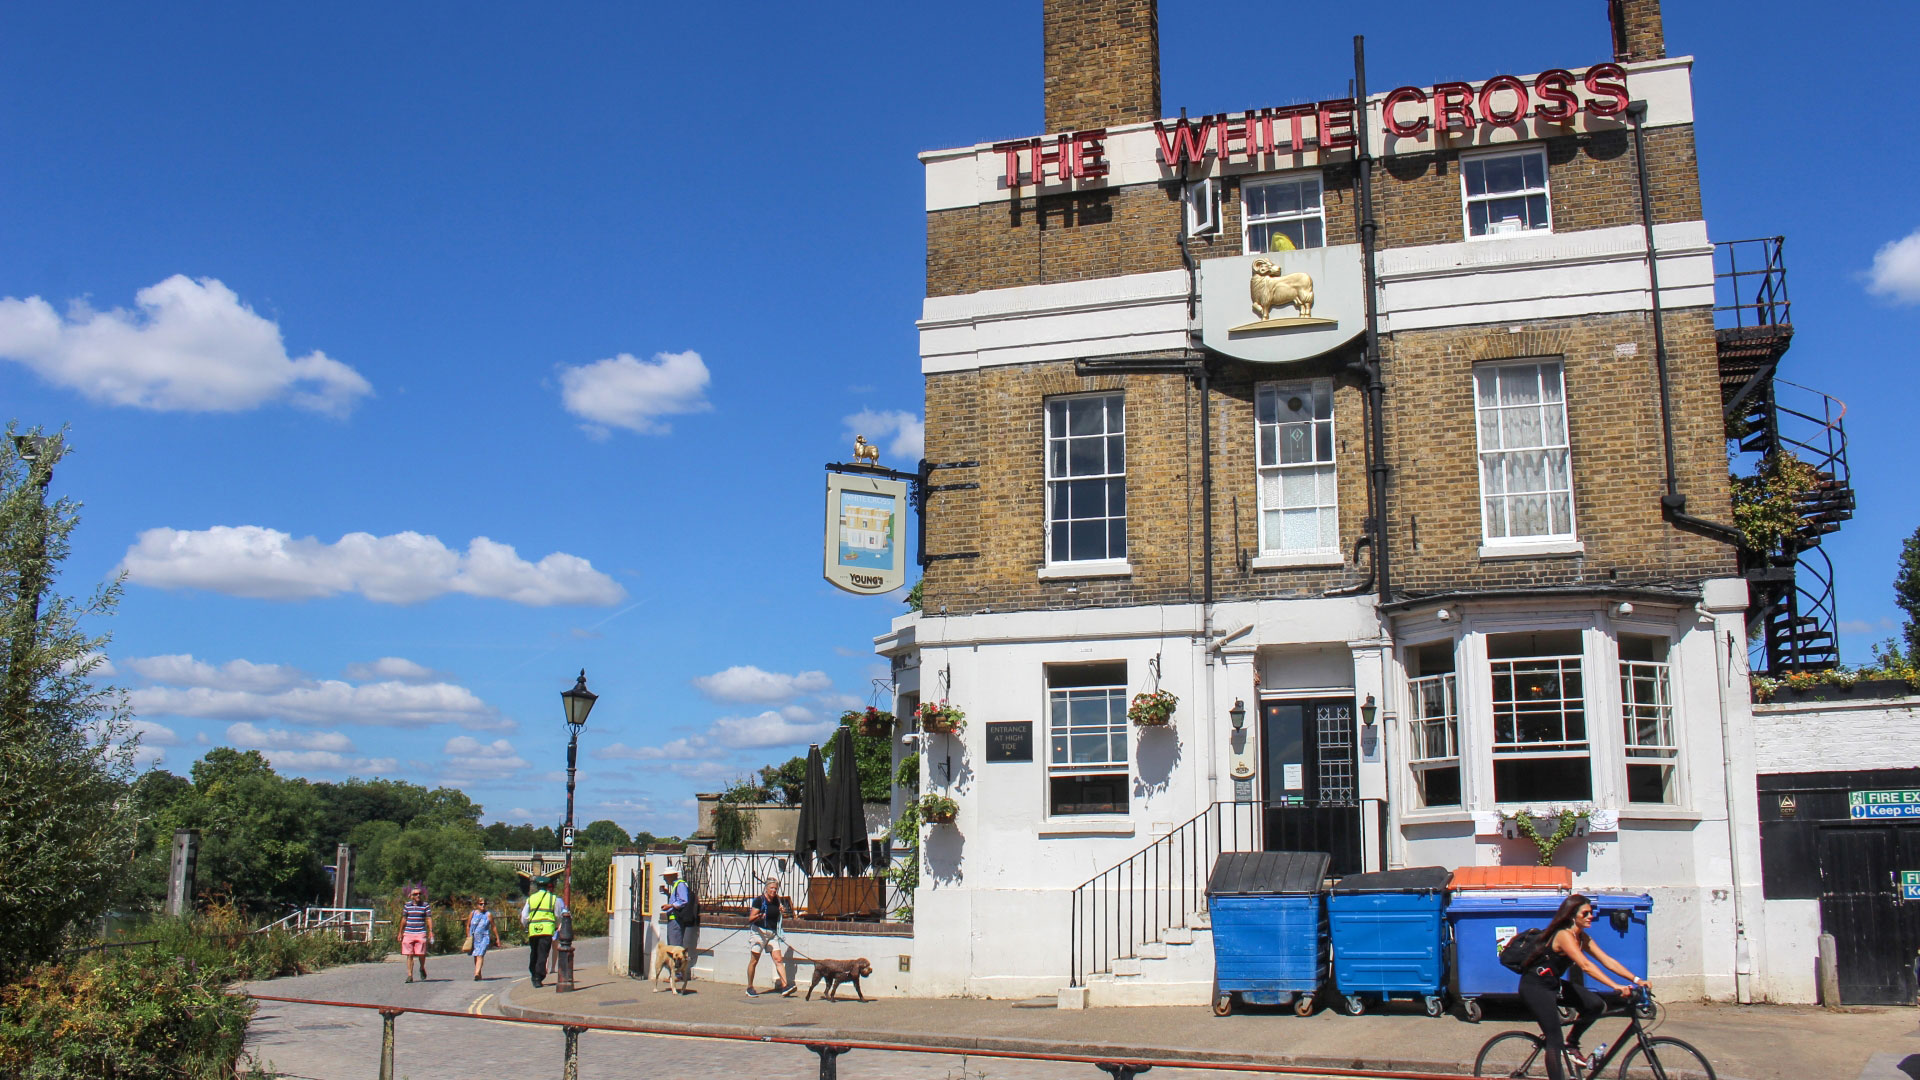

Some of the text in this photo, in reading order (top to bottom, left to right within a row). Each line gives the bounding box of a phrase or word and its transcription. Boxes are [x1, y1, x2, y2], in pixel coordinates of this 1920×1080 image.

[993, 63, 1630, 187] THE WHITE CROSS
[849, 573, 884, 585] YOUNG'S
[1005, 734, 1023, 742] HIGH
[1869, 792, 1920, 803] FIRE EX
[1869, 805, 1901, 817] Keep
